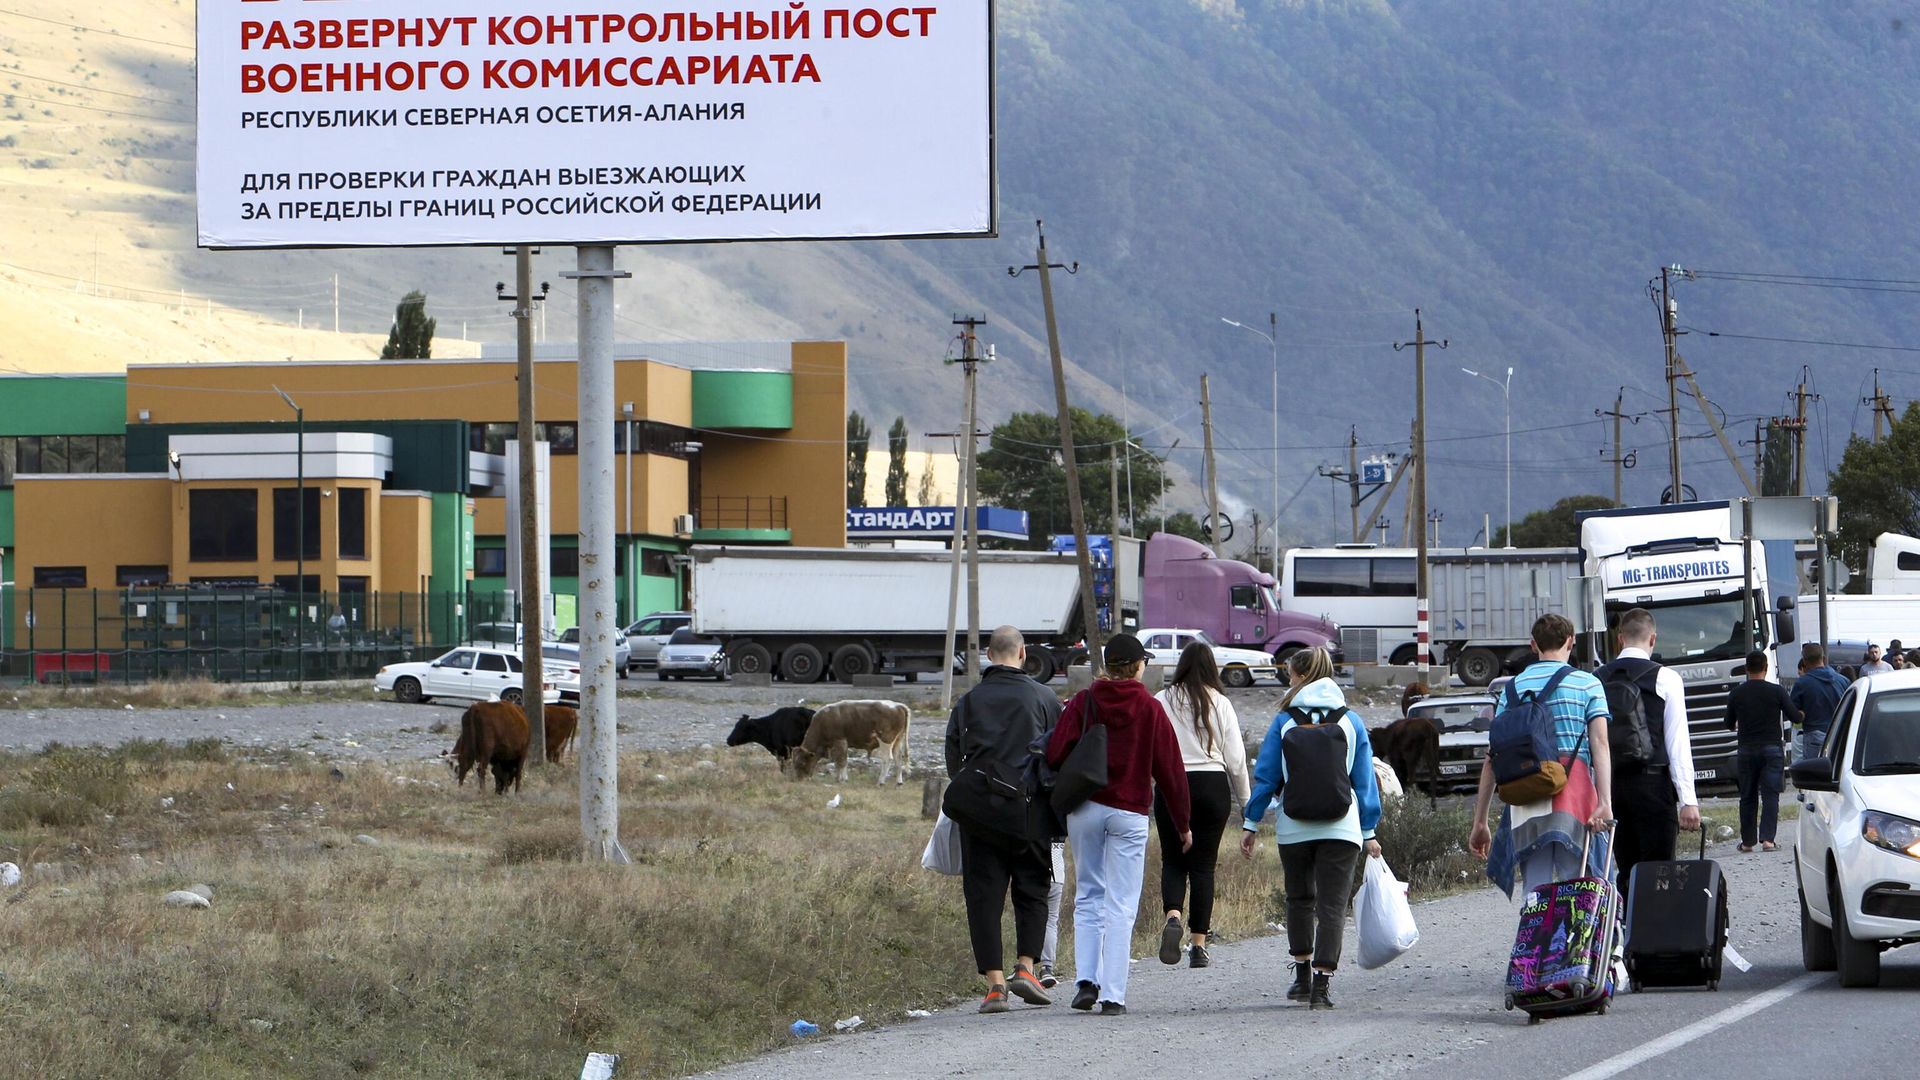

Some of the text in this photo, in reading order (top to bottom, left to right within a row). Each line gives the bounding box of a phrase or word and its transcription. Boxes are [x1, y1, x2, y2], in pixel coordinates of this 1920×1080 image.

[241, 2, 937, 51] РАЗВЕРНУТ КОНТРОЛЬНЫЙ ПОСТ
[241, 54, 822, 94] ВОЕННОГО КОМИССАРИАТА
[241, 103, 745, 129] РЕСПУБЛИКИ СЕВЕРНАЯ ОСЕТИЯ-АЛАНИЯ
[241, 165, 746, 194] ДЛЯ ПРОВЕРКИ ГРАЖДАН ВЫЕЗЖАЮЩИХ
[241, 190, 821, 222] ЗА ПРЕДЕЛЫ ГРАНИЦ РОССИЙСКОЙ ФЕДЕРАЦИИ
[1622, 560, 1730, 585] MG-TRANSPORTES
[1680, 667, 1717, 680] ANIA
[1574, 881, 1605, 896] PARIS
[1522, 902, 1548, 915] ARIS
